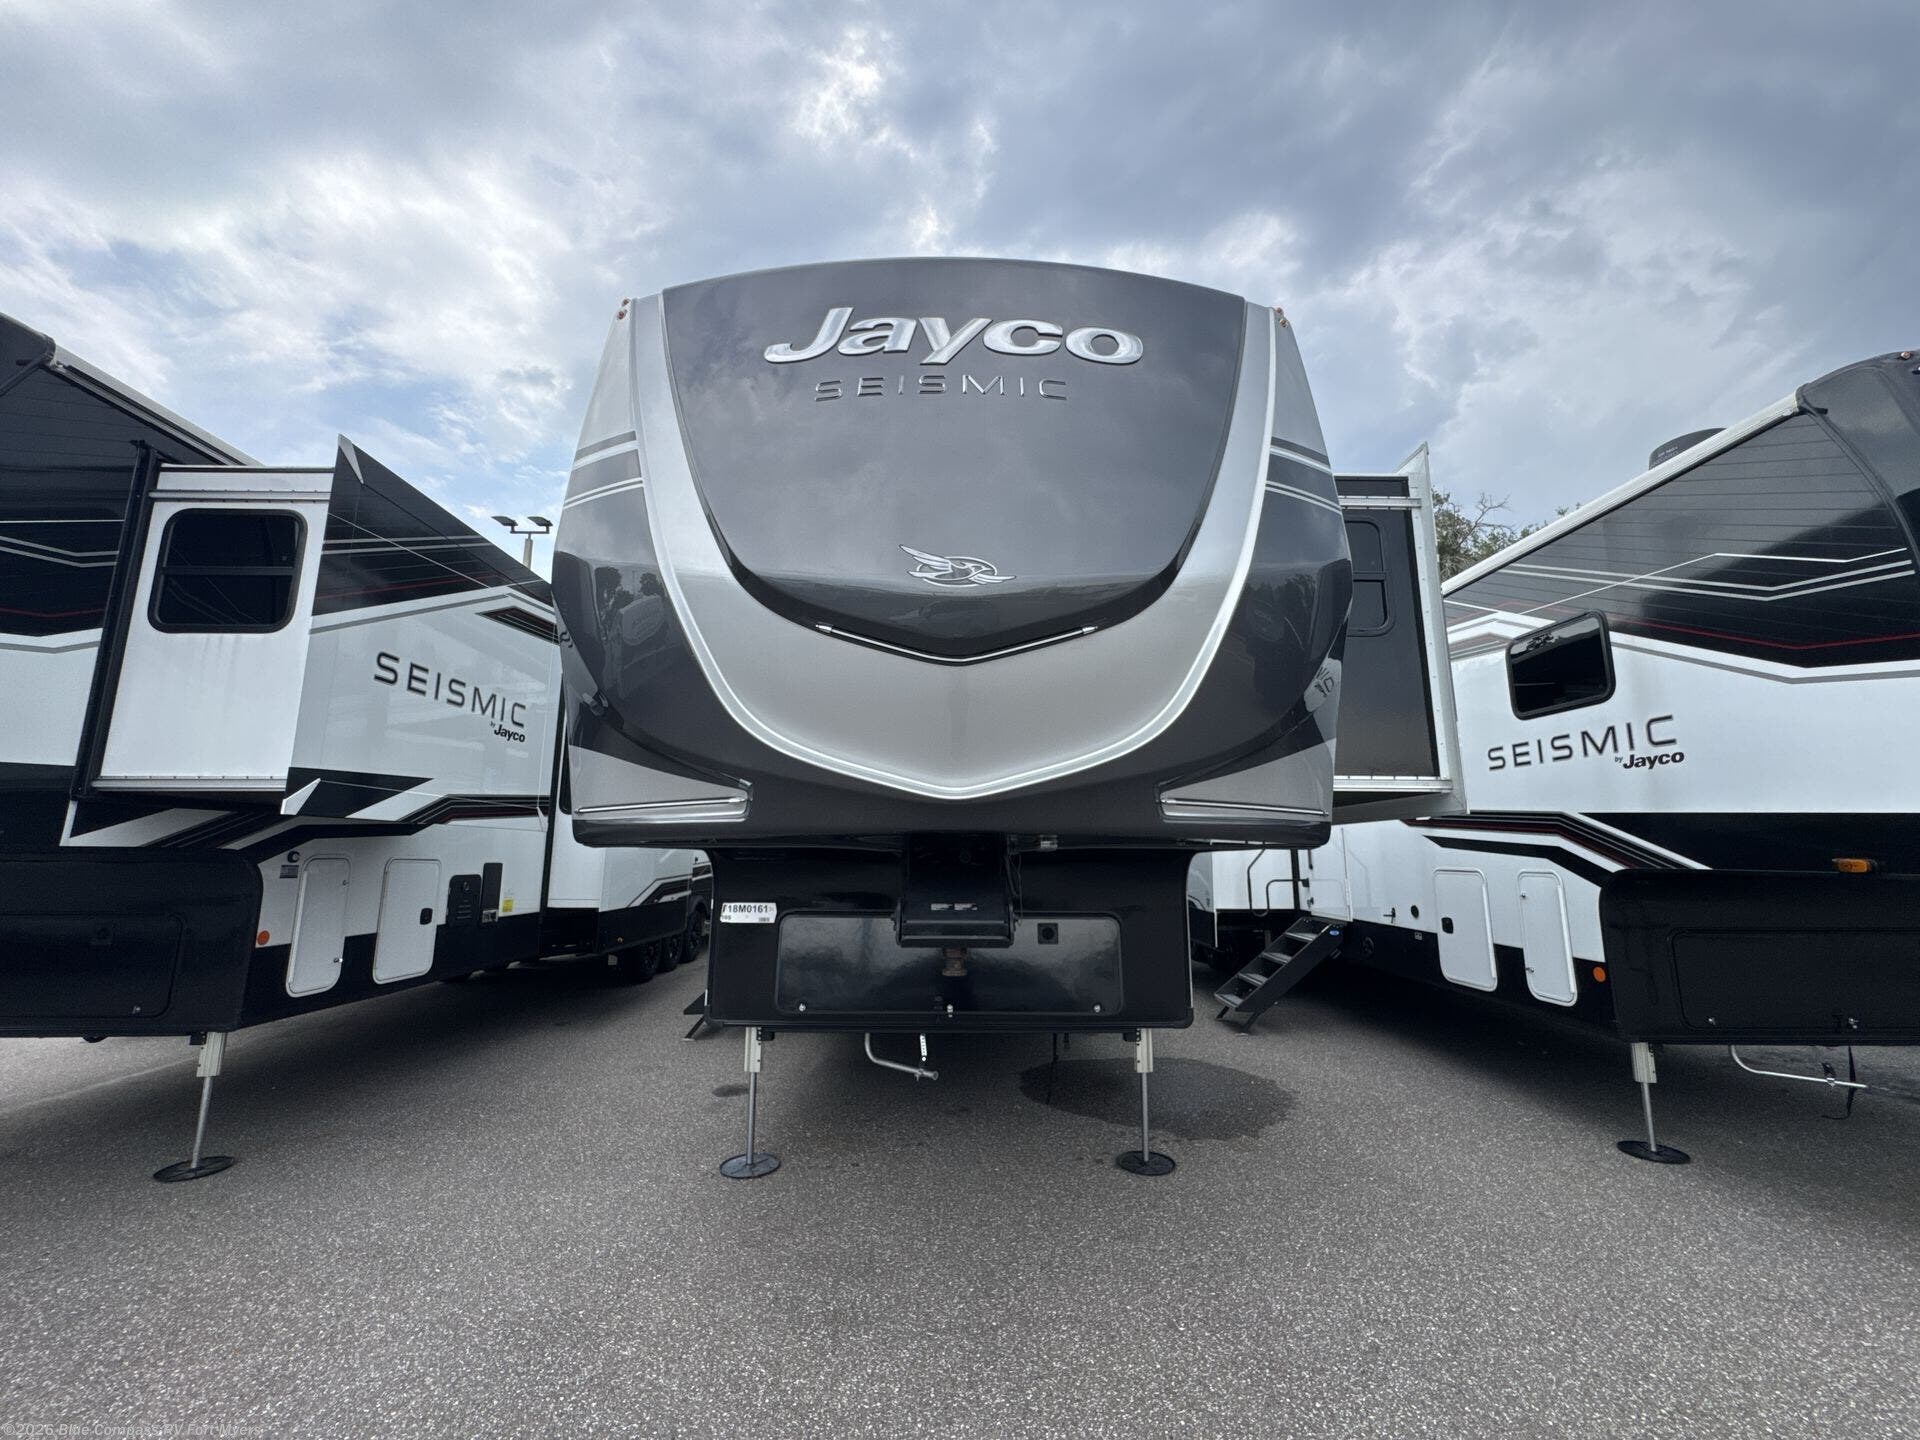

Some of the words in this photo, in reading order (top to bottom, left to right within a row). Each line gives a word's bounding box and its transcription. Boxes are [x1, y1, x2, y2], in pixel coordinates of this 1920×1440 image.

[764, 306, 1144, 365] Jayco
[815, 374, 1068, 401] SEISMIC
[374, 652, 526, 728] SEISMIC
[493, 724, 526, 742] Jayco
[1488, 715, 1677, 771] SEISMIC
[1615, 756, 1624, 765] by
[1623, 751, 1685, 769] Jayco
